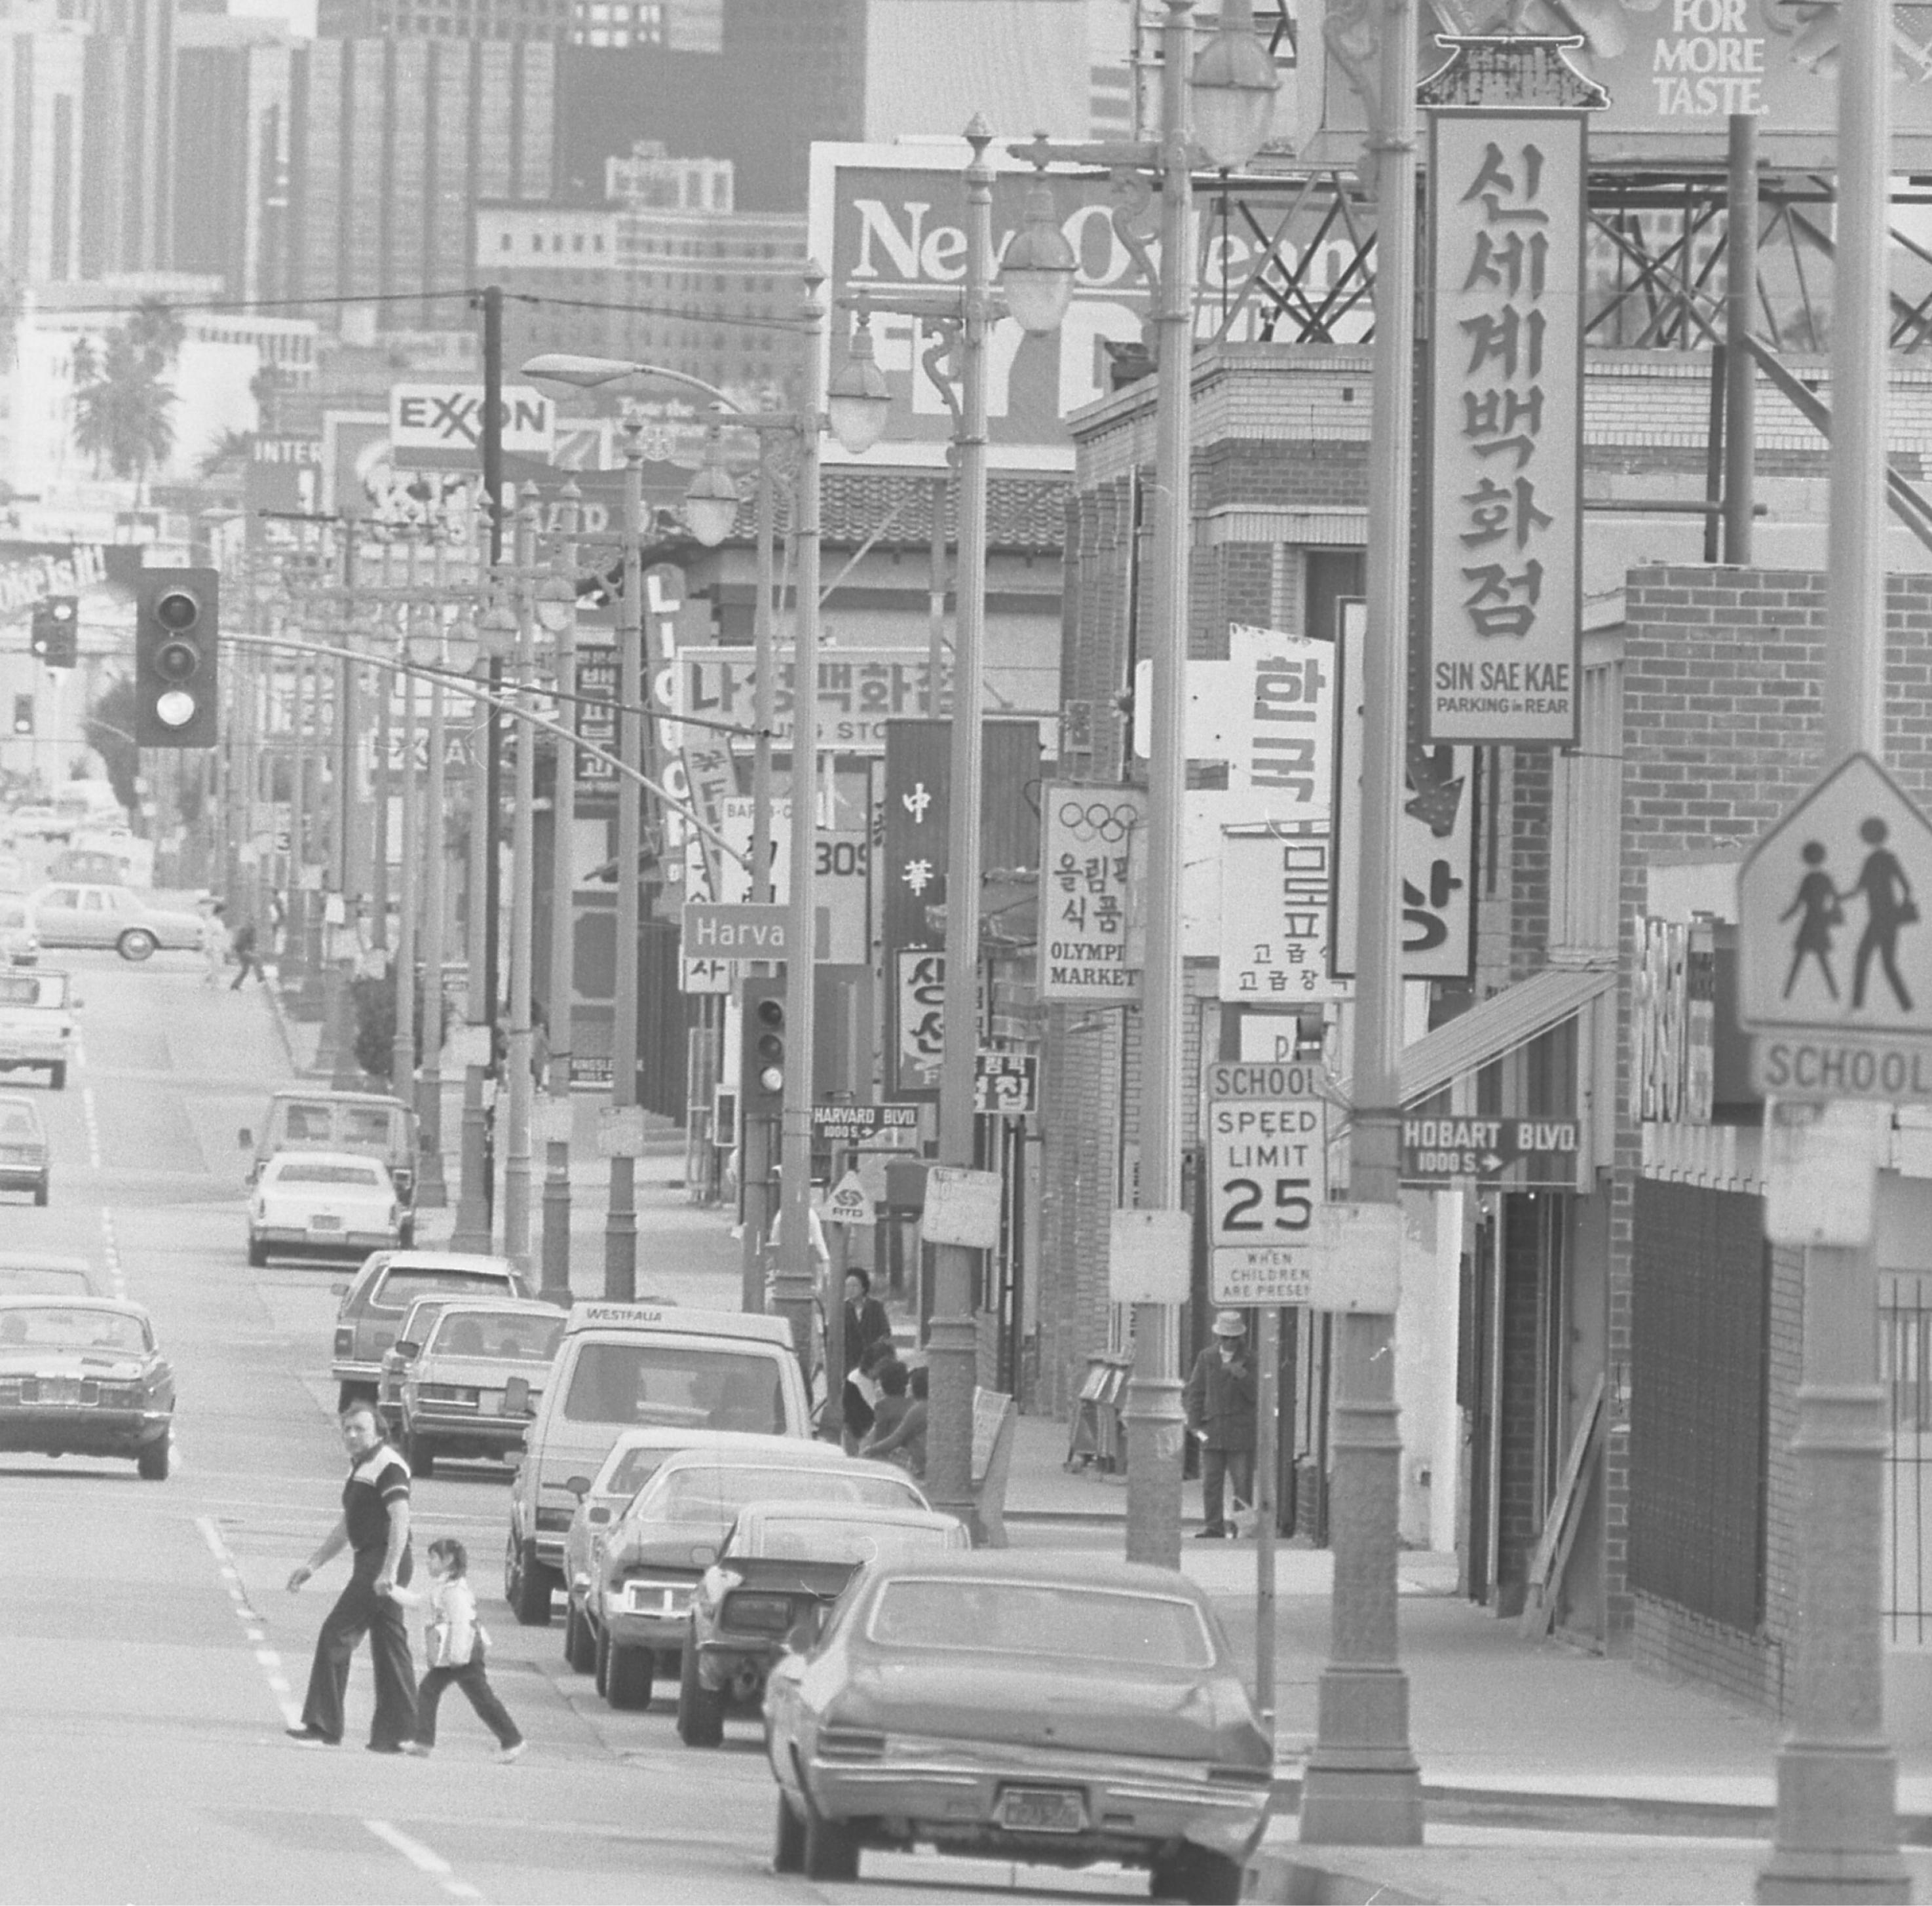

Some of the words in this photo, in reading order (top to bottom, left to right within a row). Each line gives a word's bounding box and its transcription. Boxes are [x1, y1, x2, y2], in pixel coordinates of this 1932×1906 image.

[1673, 0, 1747, 32] FOR
[1653, 37, 1765, 72] MORE
[1652, 77, 1770, 115] TASTE.
[1459, 142, 1553, 639] 신세계백화점
[400, 393, 546, 444] EXXON
[1436, 662, 1473, 691] SIN
[1481, 662, 1520, 691] SAE
[1525, 662, 1569, 691] KAE
[1437, 697, 1509, 713] PARKING
[1525, 698, 1568, 713] REAR
[901, 782, 934, 896] 中華
[1061, 896, 1123, 933] 식품
[697, 917, 785, 946] Harva
[1050, 942, 1127, 962] OLYMPI
[1050, 967, 1141, 987] MARKET
[1766, 1044, 1932, 1094] SCHOOL
[814, 1108, 874, 1124] HARVARD
[1217, 1112, 1317, 1134] SPEED
[1405, 1121, 1501, 1149] HOBART
[1230, 1145, 1308, 1167] LIMIT
[1418, 1152, 1460, 1172] 1000
[1222, 1179, 1311, 1231] 25
[1248, 1253, 1291, 1265] WHEN
[1231, 1268, 1309, 1282] CHILDREN
[1223, 1284, 1250, 1298] ARE
[1257, 1284, 1309, 1297] PRESE
[587, 1308, 662, 1322] WESTFALIA
